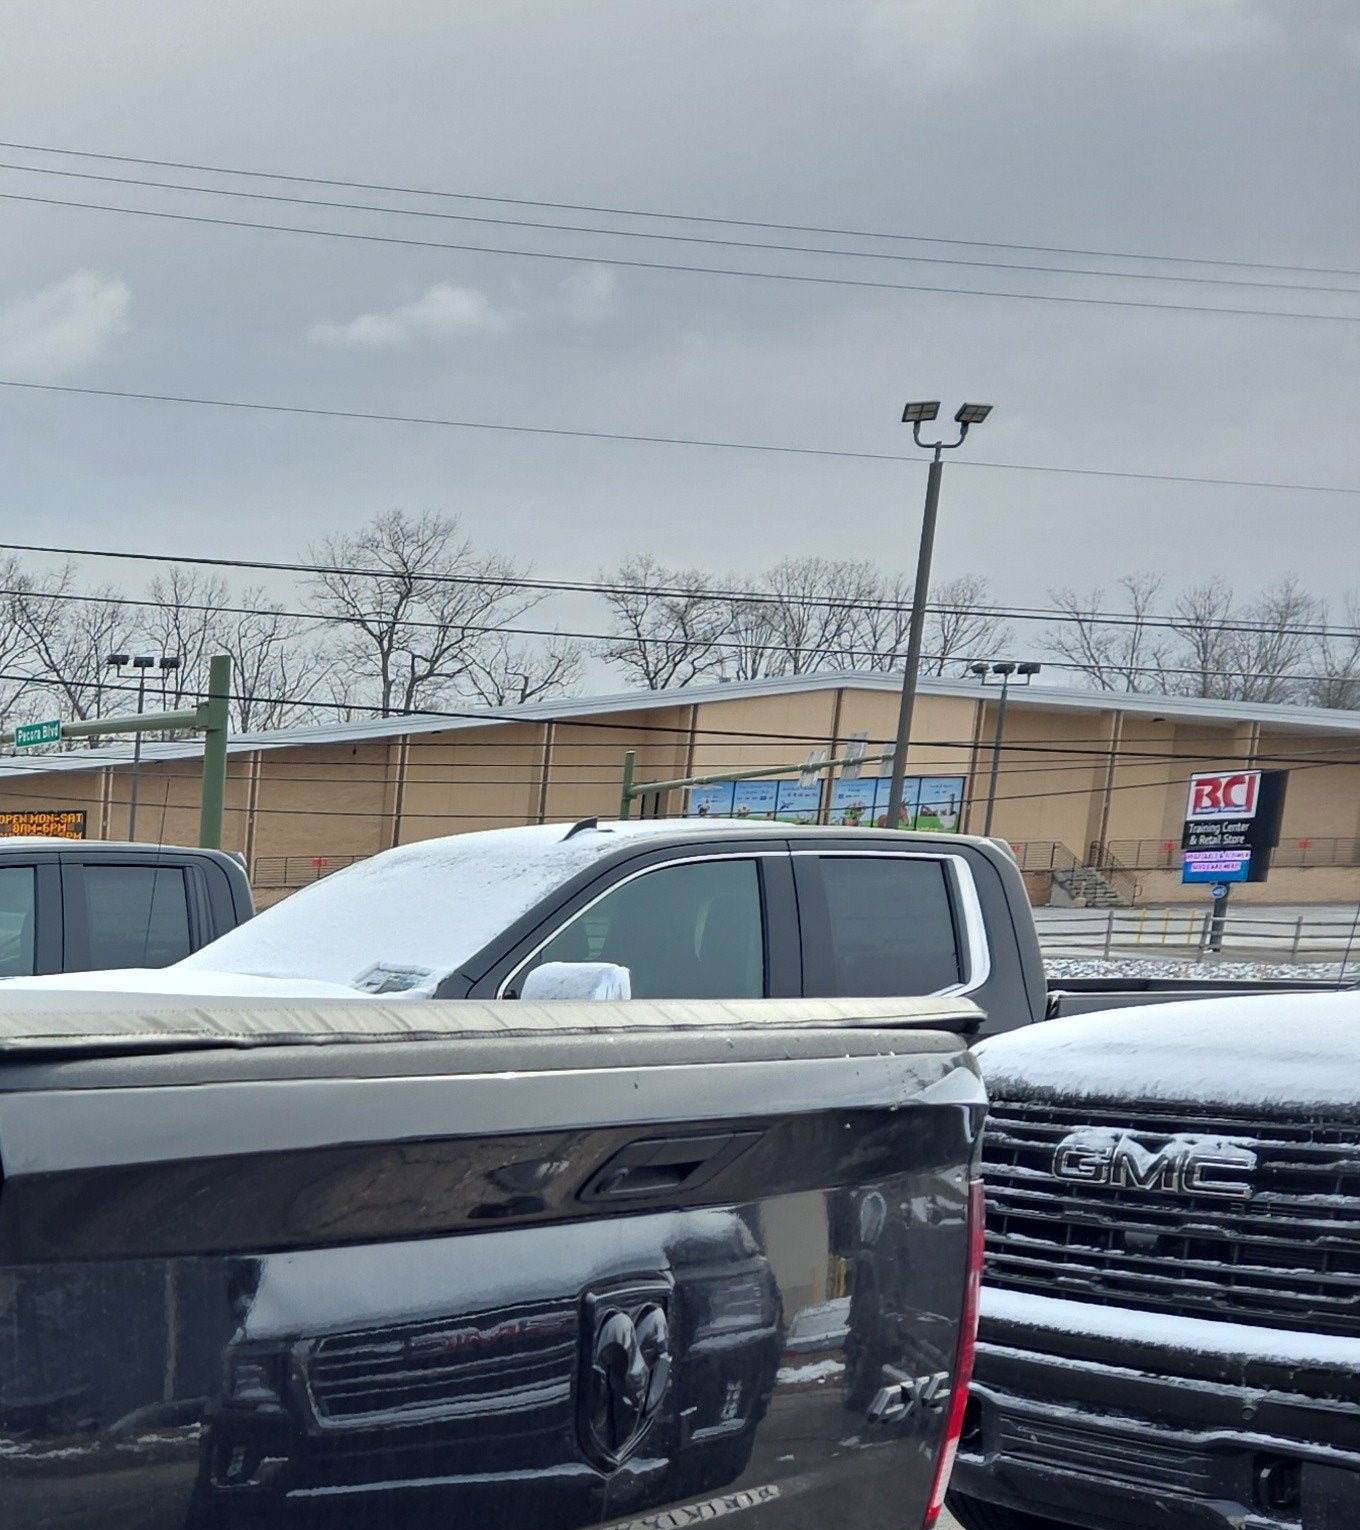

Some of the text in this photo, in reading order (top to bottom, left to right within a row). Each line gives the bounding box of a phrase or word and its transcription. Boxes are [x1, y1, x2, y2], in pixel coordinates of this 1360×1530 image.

[42, 723, 59, 739] Blvd
[30, 813, 83, 824] MON-SAT
[1189, 821, 1251, 835] Training Center
[1189, 834, 1245, 845] & Retail Store
[1052, 1136, 1258, 1200] GMC
